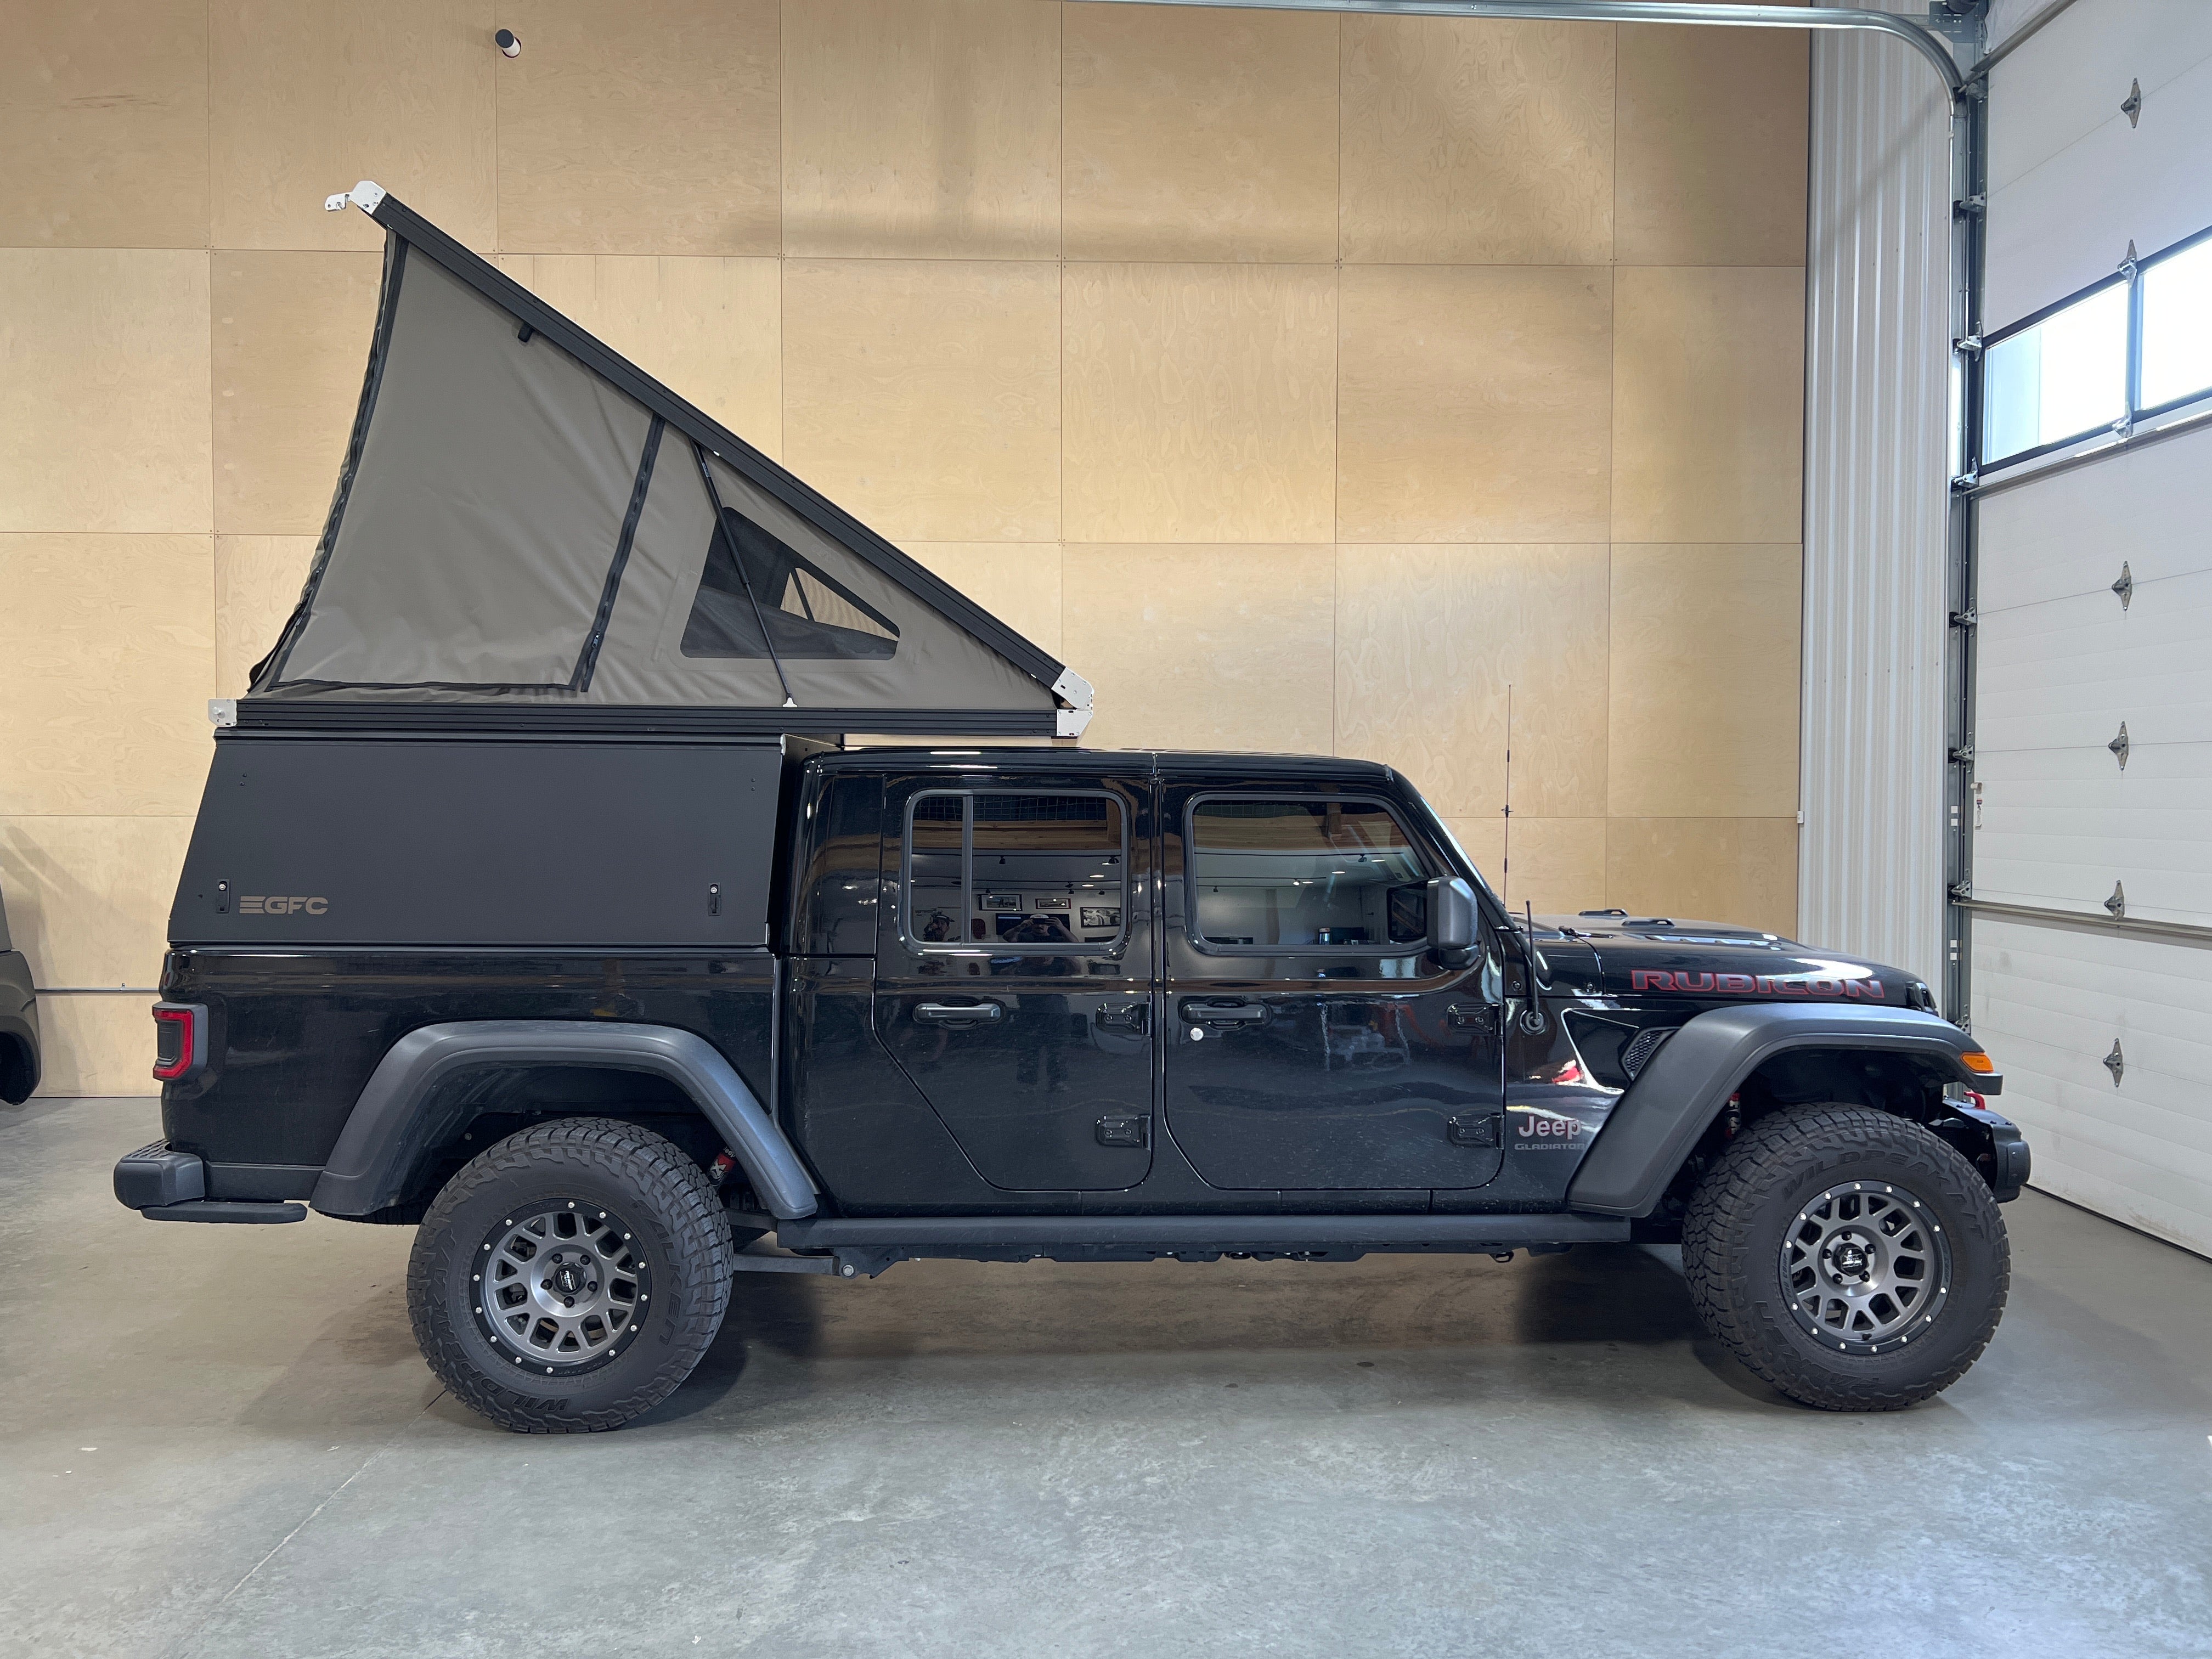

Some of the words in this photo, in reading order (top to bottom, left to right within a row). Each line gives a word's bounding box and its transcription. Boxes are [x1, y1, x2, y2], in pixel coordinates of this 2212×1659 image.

[1630, 969, 1885, 998] RUBICON
[1518, 1113, 1582, 1140] Jeep
[1783, 1149, 1951, 1201] WILDPEAK
[432, 1293, 571, 1413] WILDPEAK
